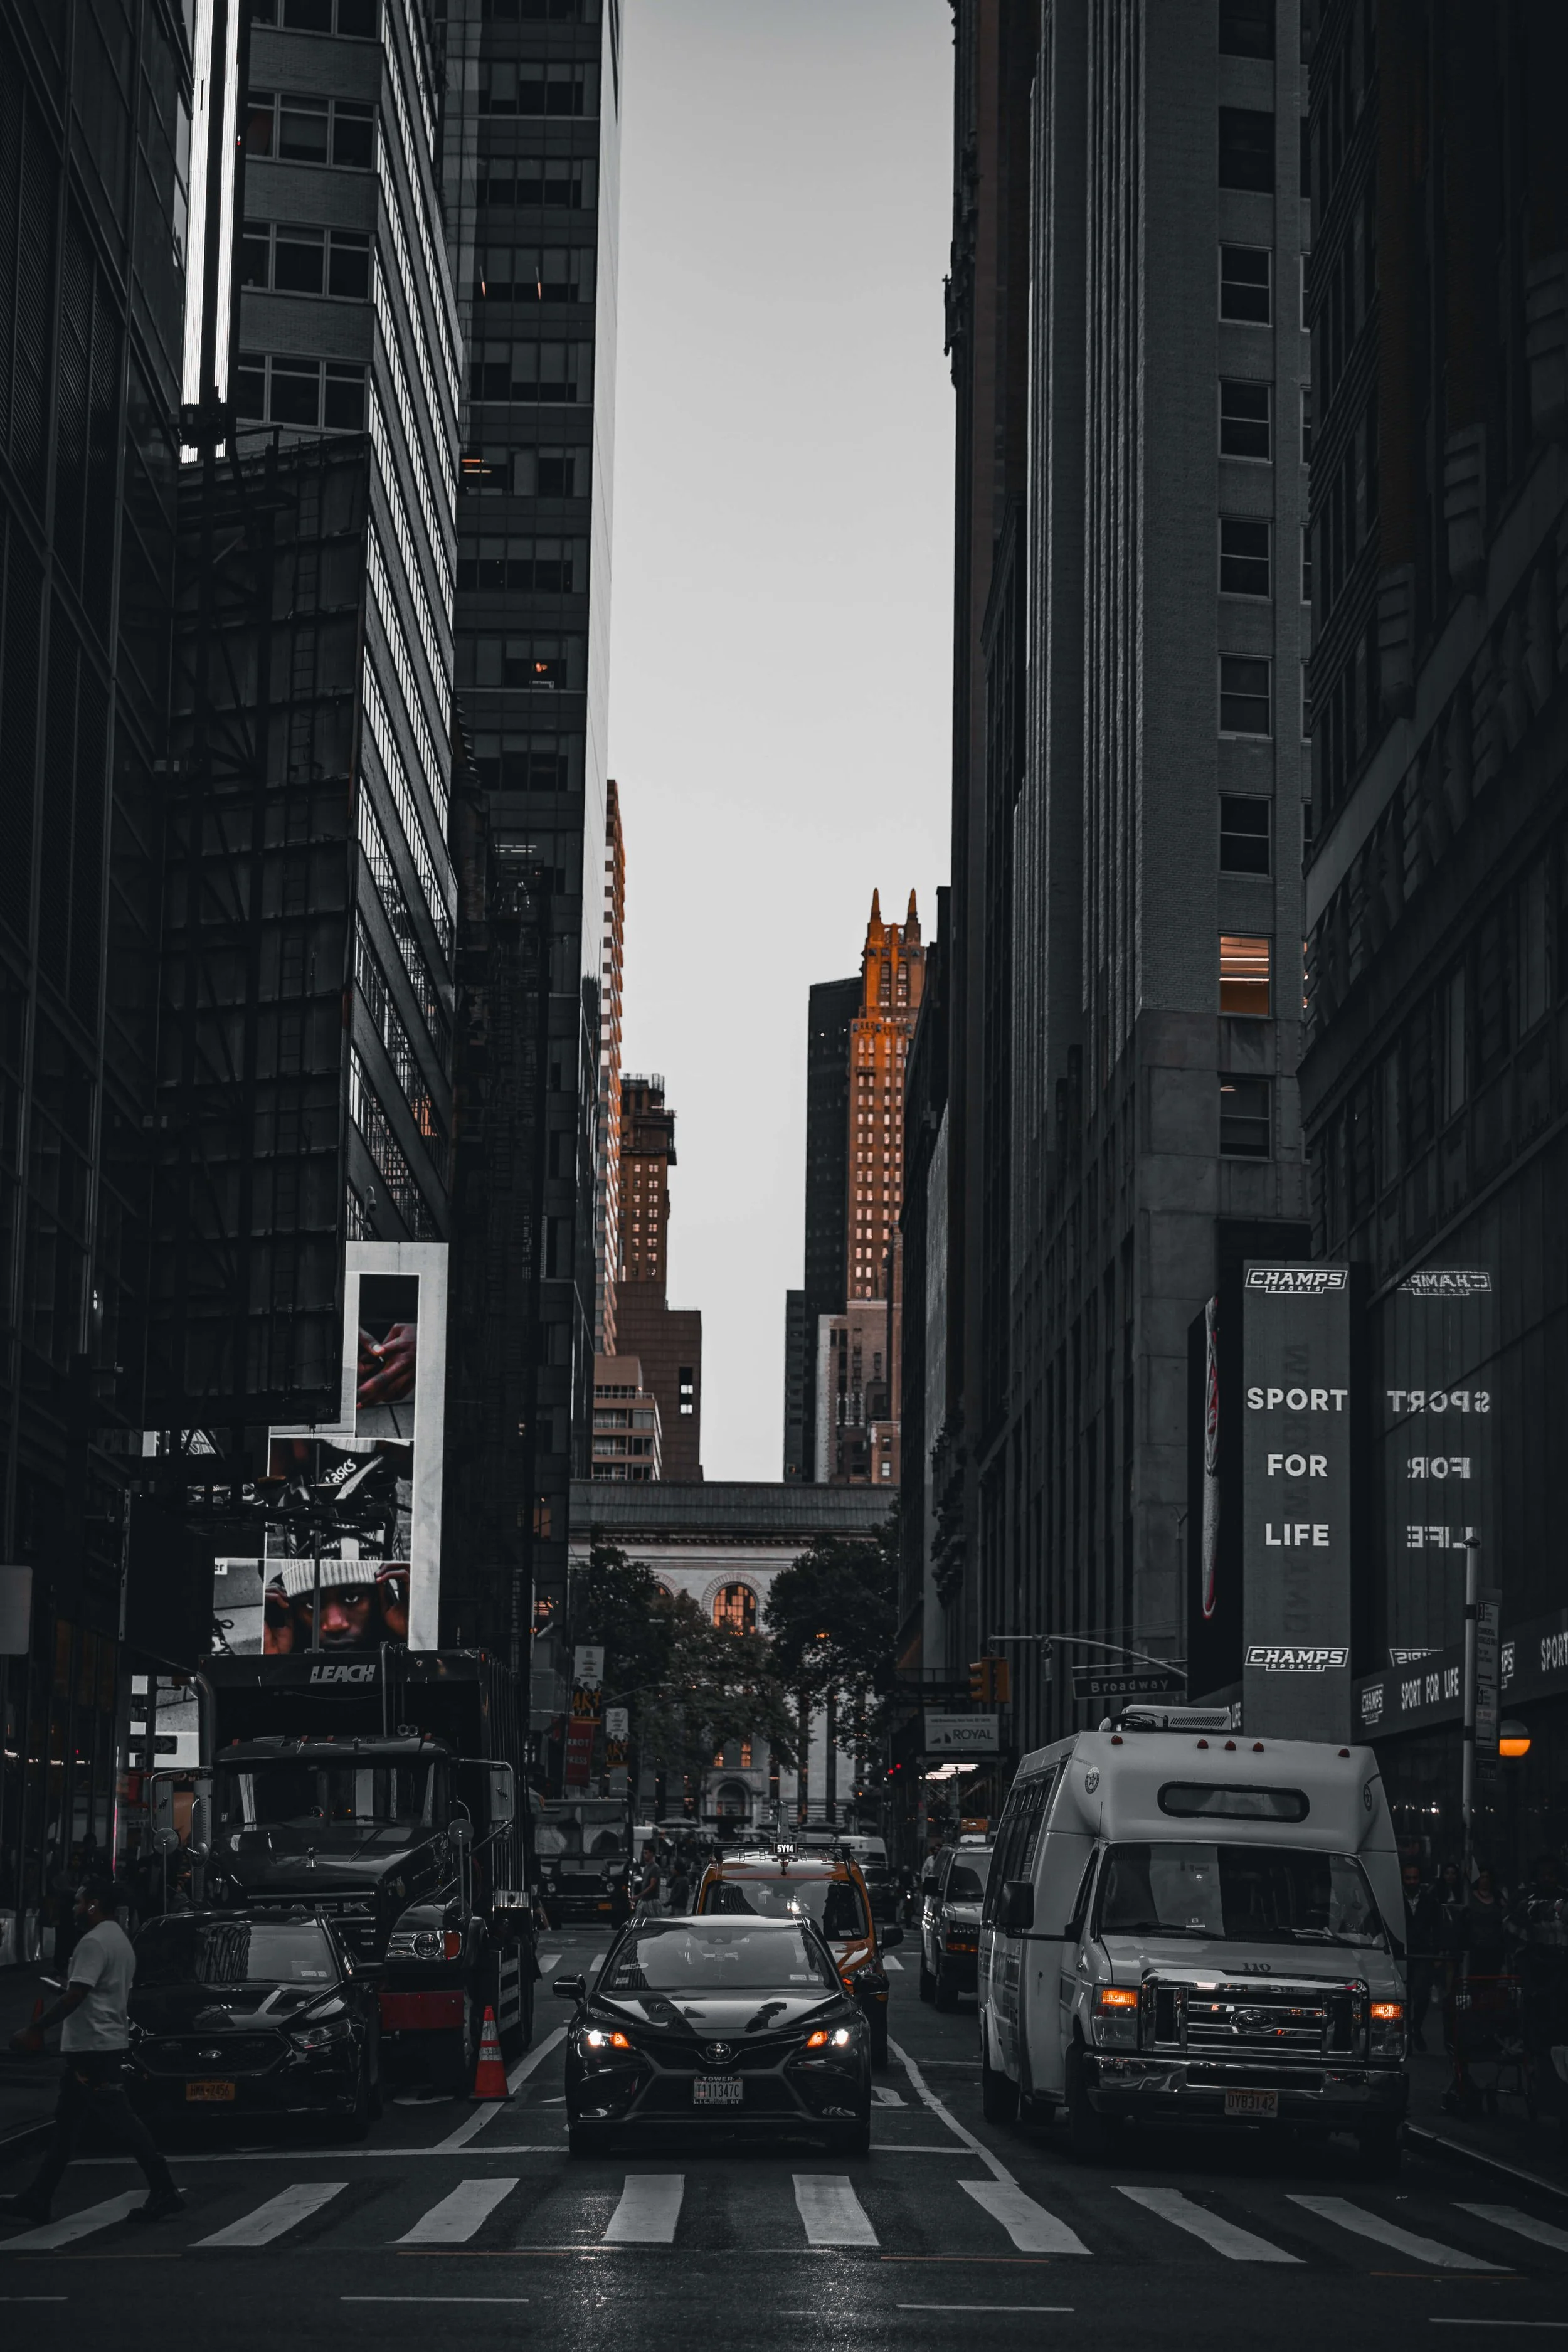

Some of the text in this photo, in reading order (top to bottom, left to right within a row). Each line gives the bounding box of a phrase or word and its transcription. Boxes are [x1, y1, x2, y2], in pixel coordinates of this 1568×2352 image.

[1250, 1271, 1343, 1286] CHAMPS
[1247, 1387, 1348, 1411] SPORT
[1268, 1454, 1328, 1477] FOR
[1266, 1523, 1330, 1547] LIFE
[1250, 1650, 1344, 1664] CHAMPS
[310, 1665, 376, 1683] LEACH
[1091, 1679, 1169, 1693] Broadway
[1401, 1678, 1421, 1710] SPORT
[1426, 1673, 1439, 1703] FOR
[1444, 1666, 1459, 1699] LIFE
[1362, 1689, 1384, 1713] CHAMPS
[953, 1729, 994, 1740] ROYAL
[777, 1844, 793, 1853] 5Y14
[1242, 1963, 1271, 1972] 110
[697, 2084, 739, 2098] T111347C
